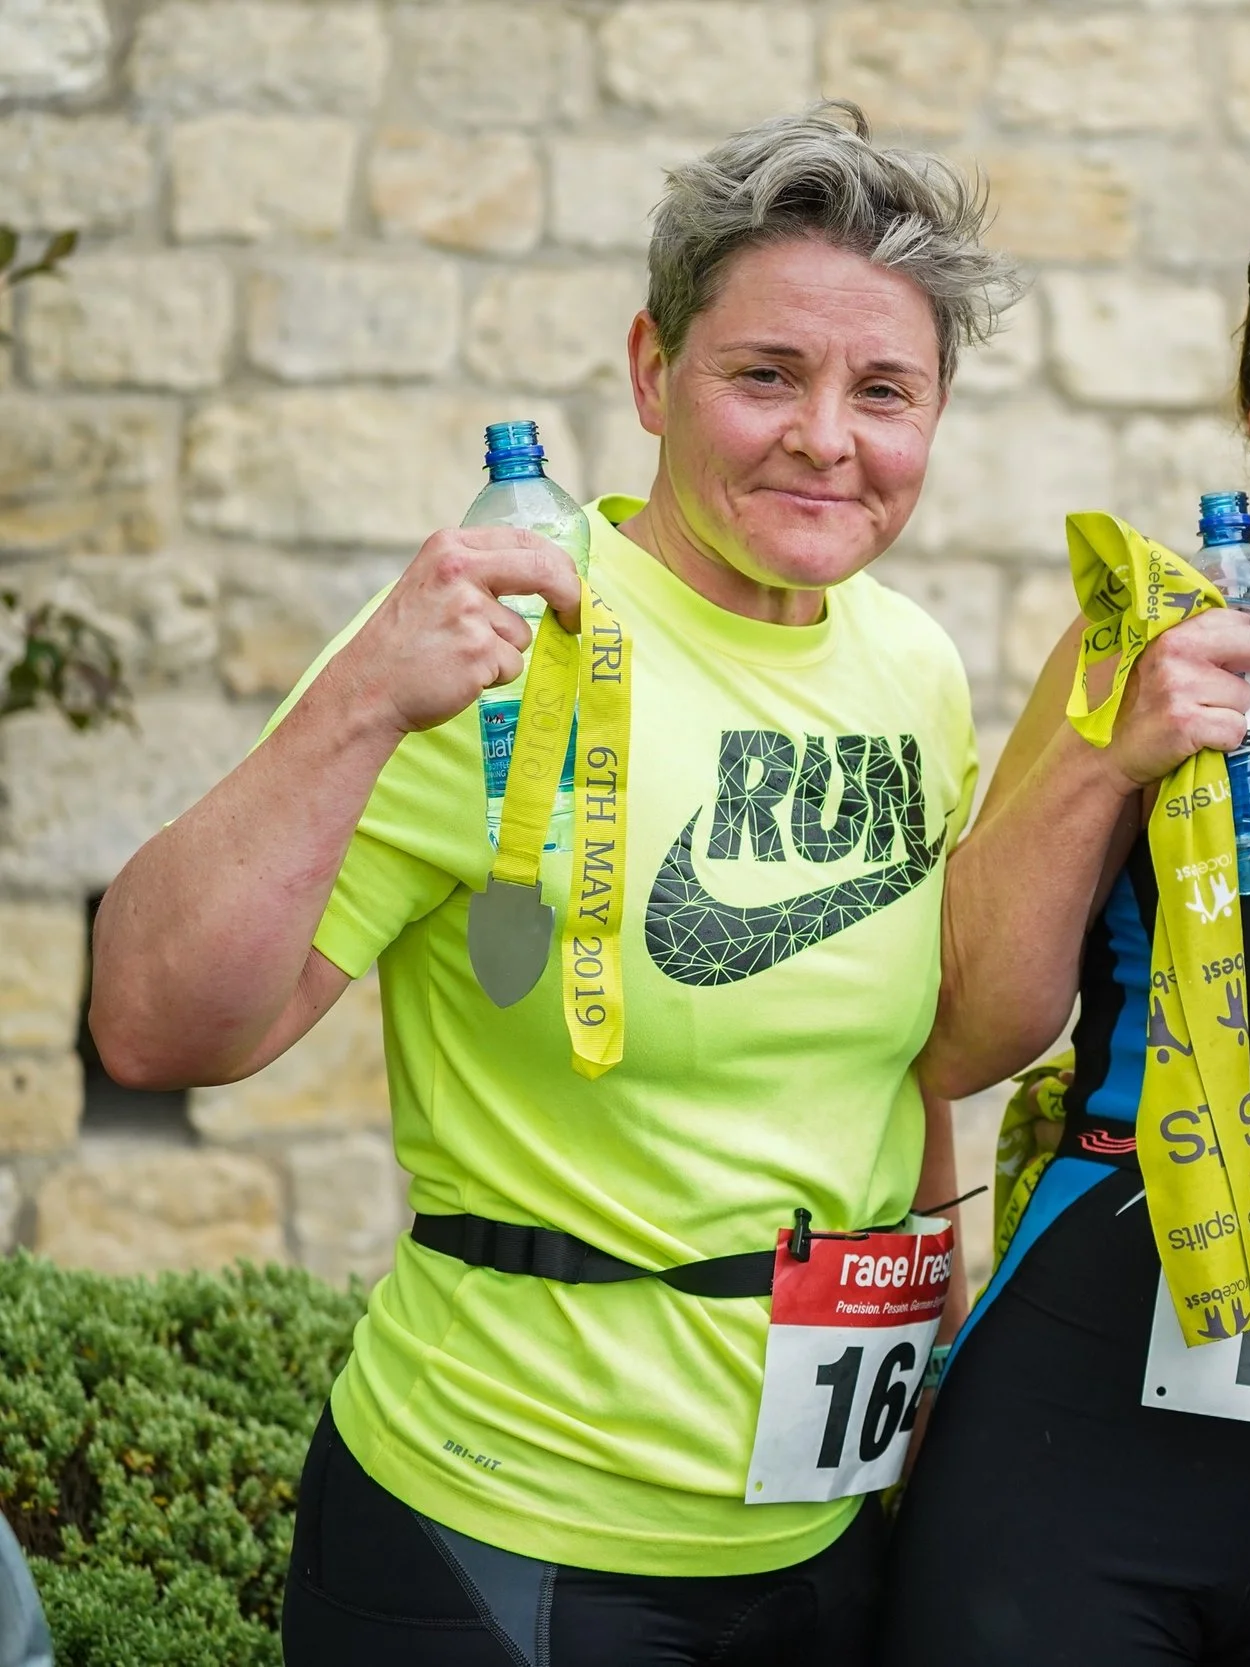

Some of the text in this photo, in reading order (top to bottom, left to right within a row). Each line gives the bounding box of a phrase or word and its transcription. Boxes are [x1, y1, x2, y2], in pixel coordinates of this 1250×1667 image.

[1148, 550, 1165, 622] acebest
[591, 620, 622, 684] TRI
[585, 746, 618, 832] 6TH
[706, 729, 928, 863] RUN
[577, 837, 615, 926] MAY
[572, 935, 606, 1029] 2019
[839, 1248, 953, 1288] race res
[835, 1300, 881, 1315] Precision.
[442, 1439, 502, 1471] DRI-FIT
